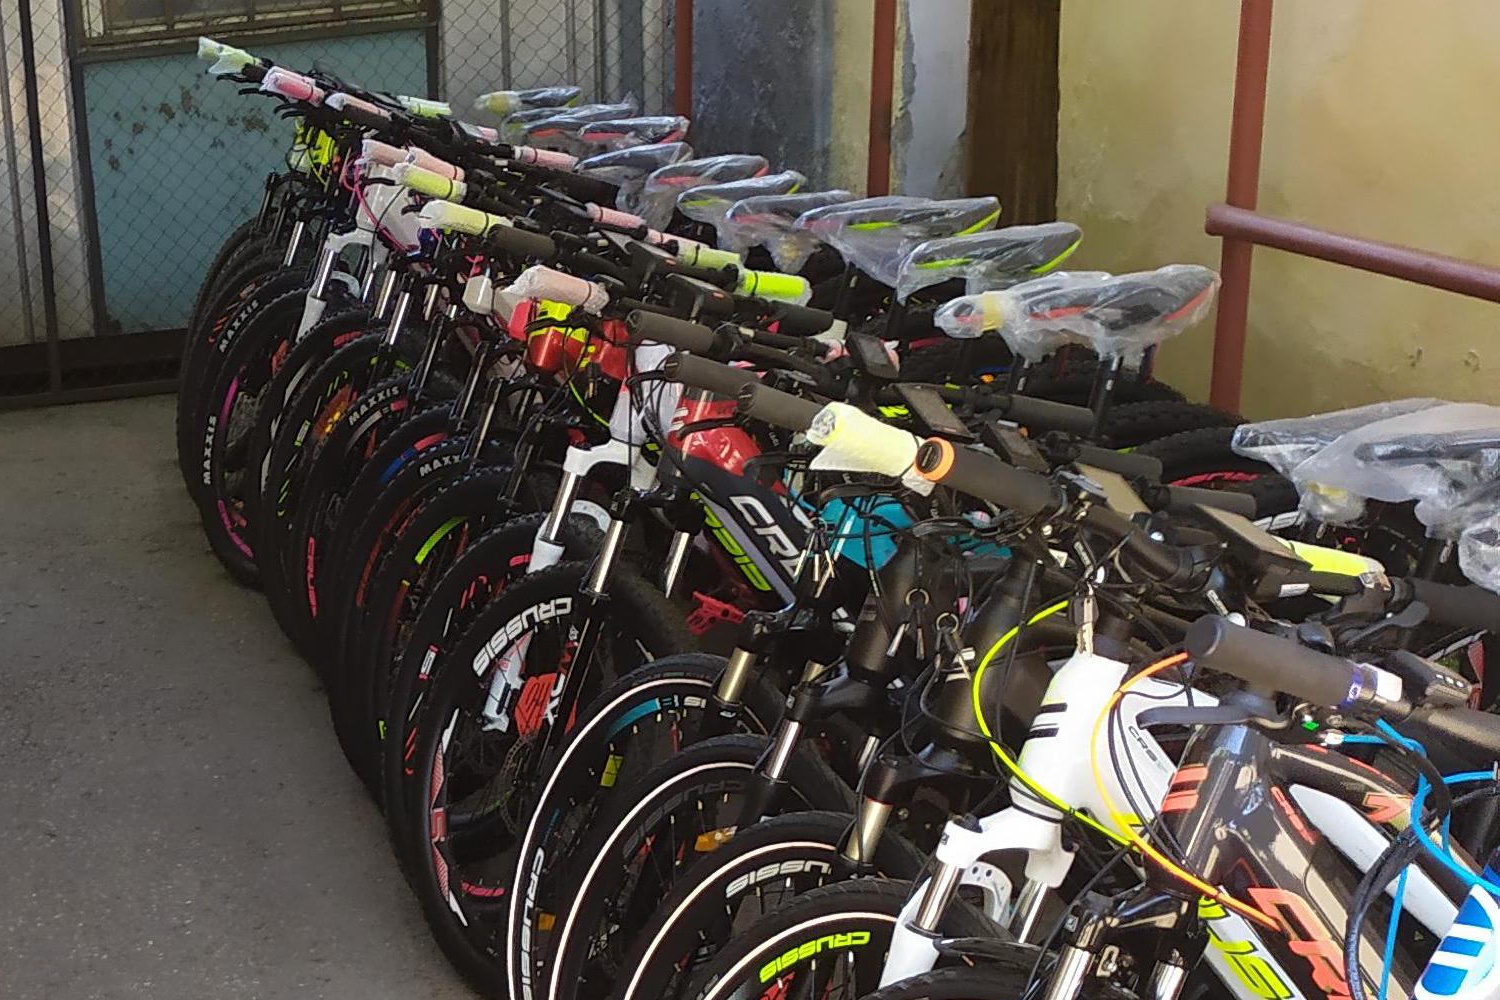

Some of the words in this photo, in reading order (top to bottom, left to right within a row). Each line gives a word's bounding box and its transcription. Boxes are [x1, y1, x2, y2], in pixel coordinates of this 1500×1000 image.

[218, 300, 260, 353] MAXXIS
[349, 385, 401, 426] MAXXIS
[203, 415, 218, 485] MAXXIS
[419, 455, 462, 478] MAXX
[472, 597, 573, 677] CRUSSIS
[725, 859, 830, 898] USSIS
[759, 930, 871, 983] CRUSSIS
